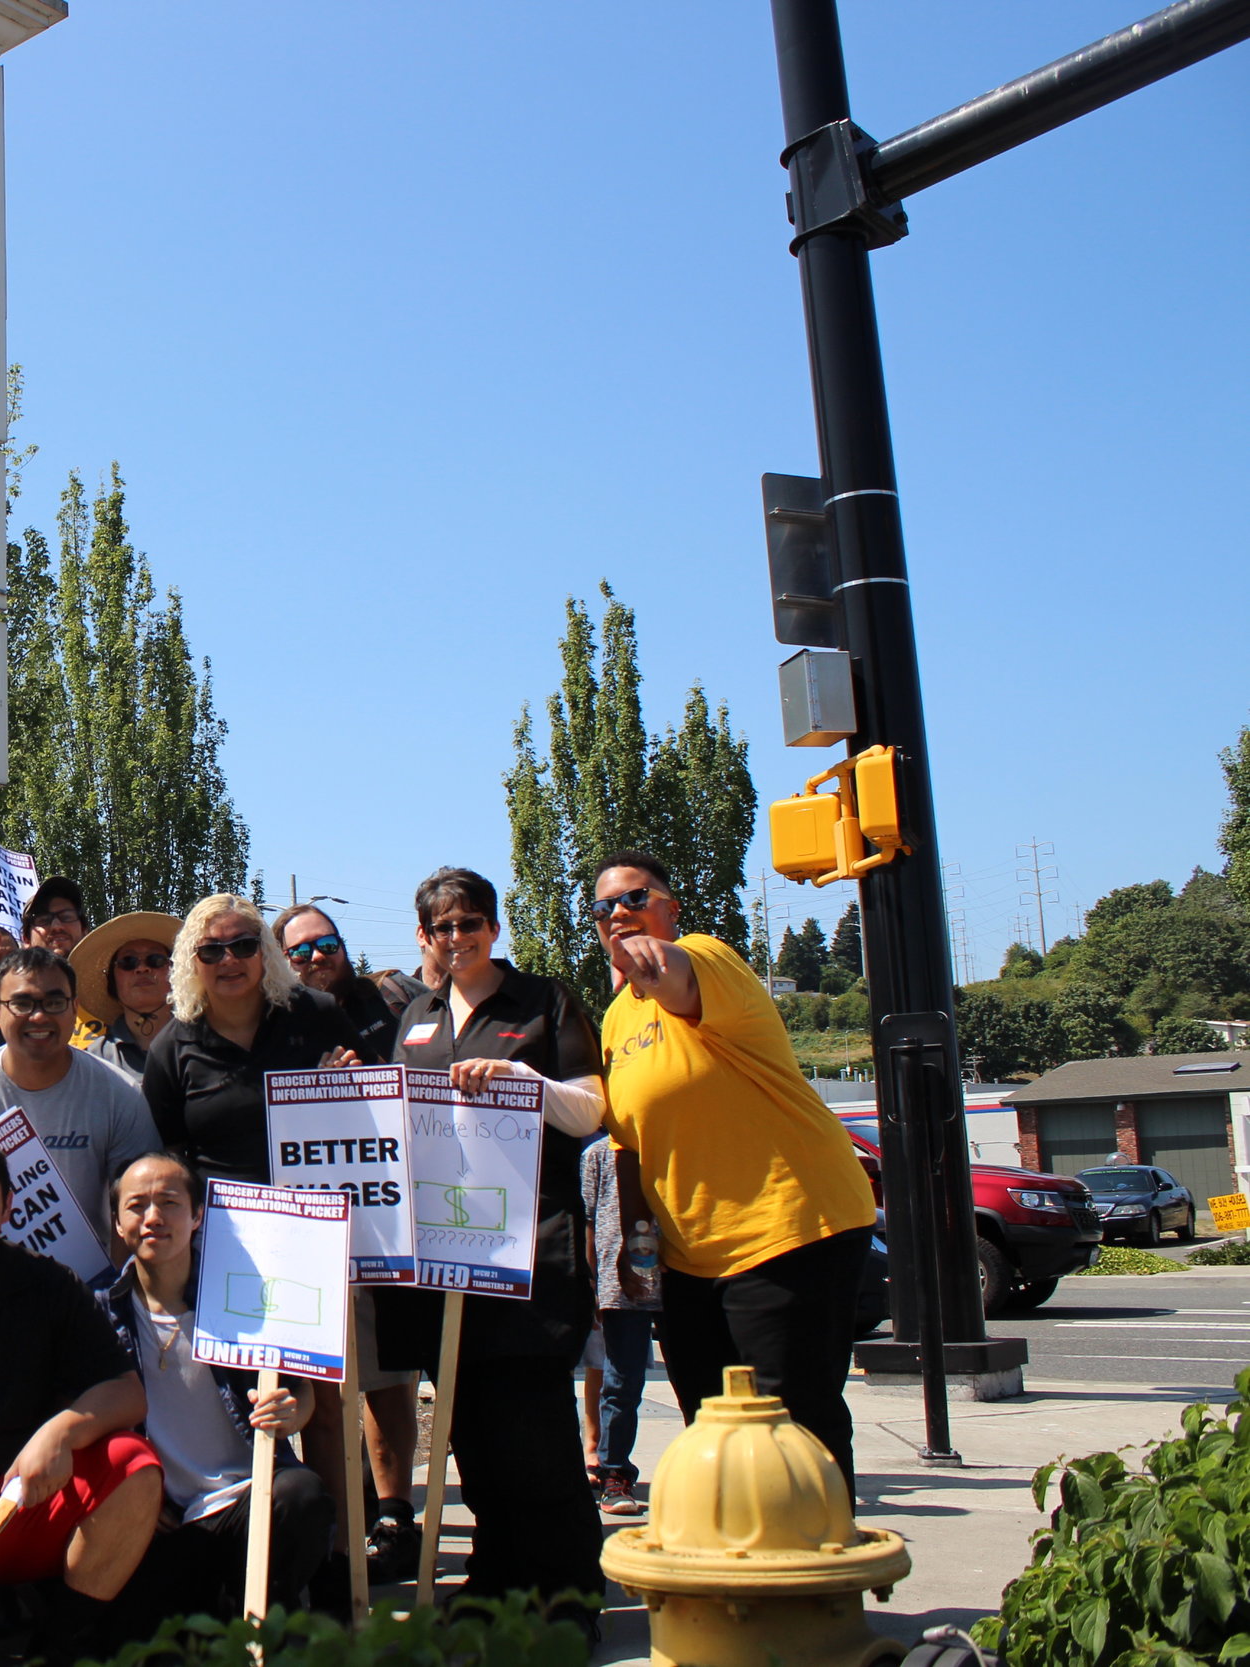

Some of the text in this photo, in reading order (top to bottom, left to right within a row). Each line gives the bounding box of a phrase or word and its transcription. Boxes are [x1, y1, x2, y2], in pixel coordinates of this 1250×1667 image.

[271, 1070, 399, 1088] GROCERY STORE WORKERS
[488, 1079, 539, 1094] WORKERS
[272, 1083, 400, 1101] INFORMATIONAL PICKET
[497, 1093, 539, 1108] PICKET
[410, 1108, 468, 1138] Where
[494, 1114, 539, 1141] Our
[43, 1131, 90, 1149] ada
[280, 1138, 399, 1167] BETTER
[213, 1184, 345, 1205] GROCERY STORE WORKERS
[283, 1181, 401, 1207] GES
[9, 1183, 61, 1230] CAN
[213, 1194, 344, 1219] INFORMATIONAL PICKET
[360, 1260, 377, 1268] UFCW
[361, 1271, 392, 1279] TEAMSTERS
[418, 1260, 470, 1289] ITED
[473, 1269, 498, 1279] UFCW 21
[472, 1280, 504, 1290] TEAMSTERS
[197, 1338, 281, 1368] UNITED
[284, 1351, 310, 1362] UFCW 21
[284, 1360, 317, 1373] TEAMSTERS
